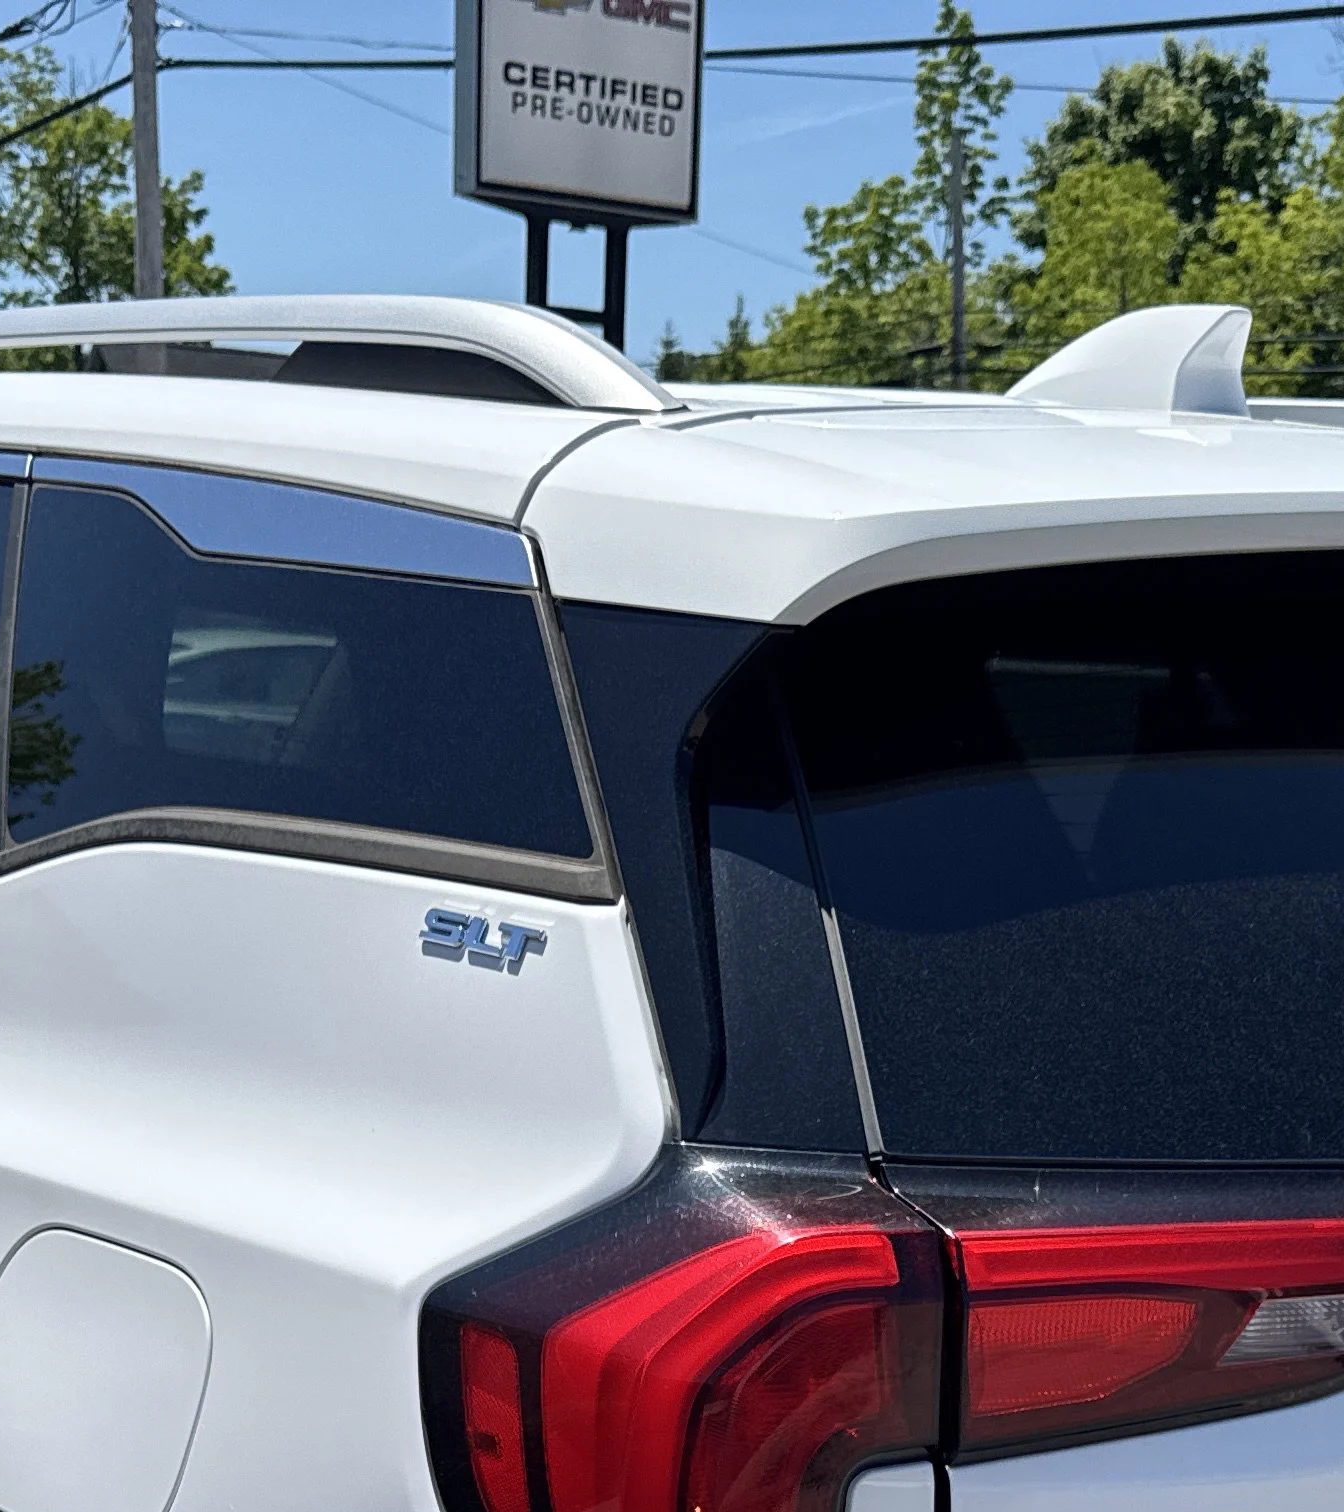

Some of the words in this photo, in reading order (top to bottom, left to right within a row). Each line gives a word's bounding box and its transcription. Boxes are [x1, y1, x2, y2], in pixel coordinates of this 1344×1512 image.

[504, 61, 684, 111] CERTIFIED
[511, 91, 676, 137] PRE-OWNED
[419, 907, 548, 963] SLT
